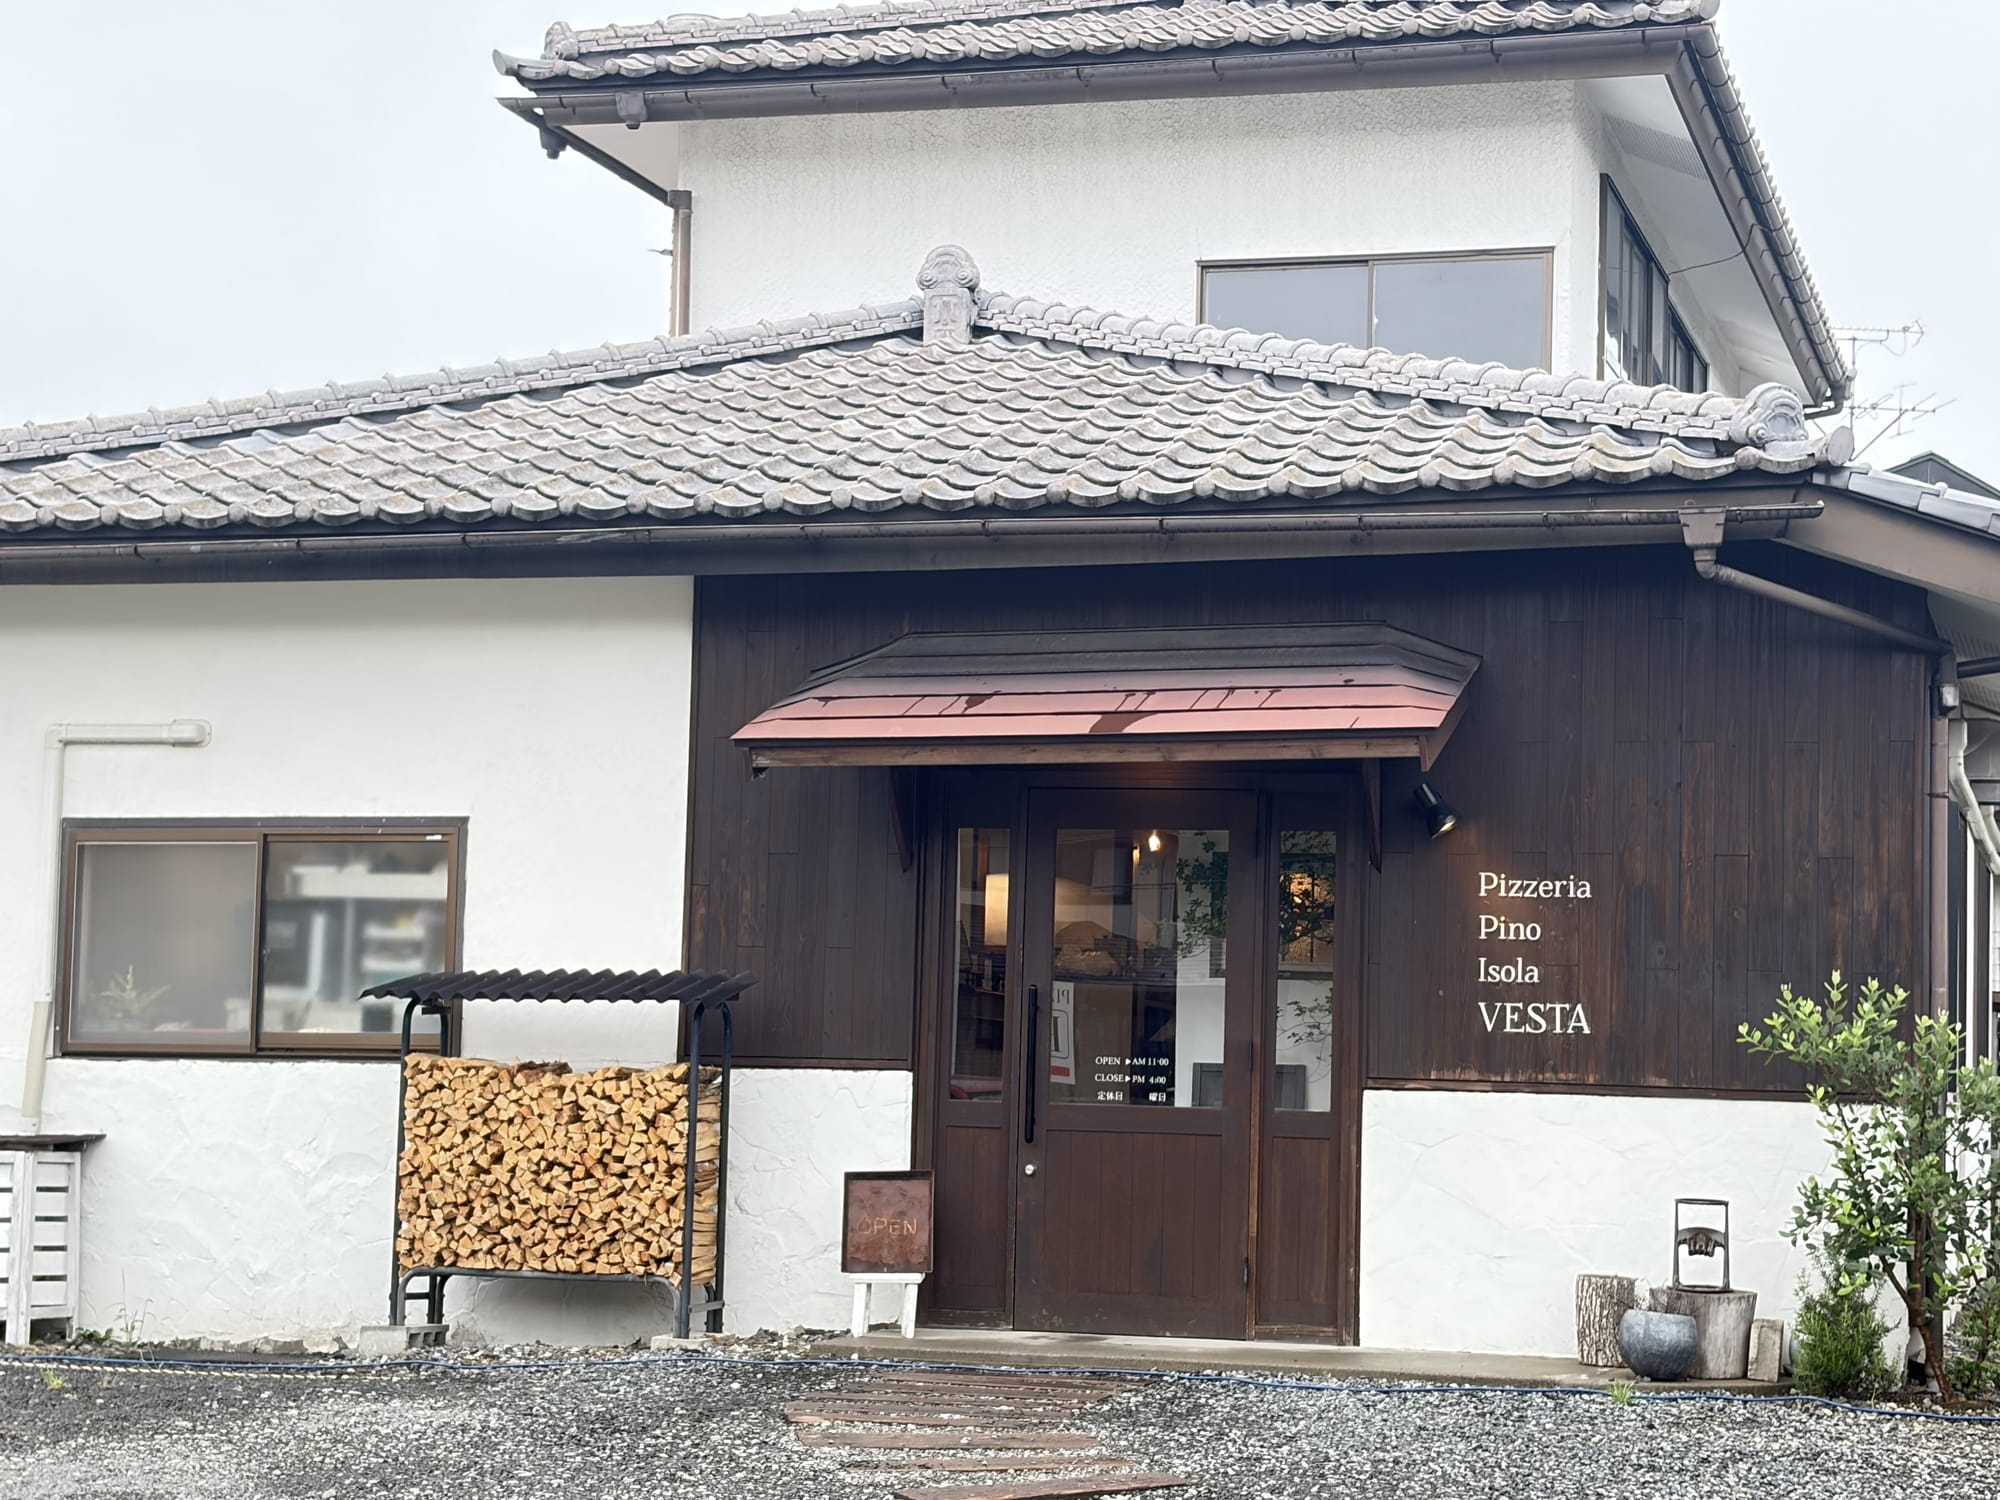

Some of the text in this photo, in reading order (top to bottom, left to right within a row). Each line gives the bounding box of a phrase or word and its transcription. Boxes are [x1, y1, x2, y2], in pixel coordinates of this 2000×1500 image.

[1478, 872, 1592, 898] Pizzeria
[1478, 915, 1541, 941] Pino
[1477, 957, 1540, 983] Isola
[1477, 1002, 1591, 1034] VESTA
[1095, 1056, 1121, 1065] OPEN
[1132, 1057, 1146, 1066] AM
[1094, 1073, 1167, 1084] CLOSE PM 4:00
[1097, 1090, 1167, 1102] 定休日 曜日
[857, 1216, 918, 1236] OPEN
